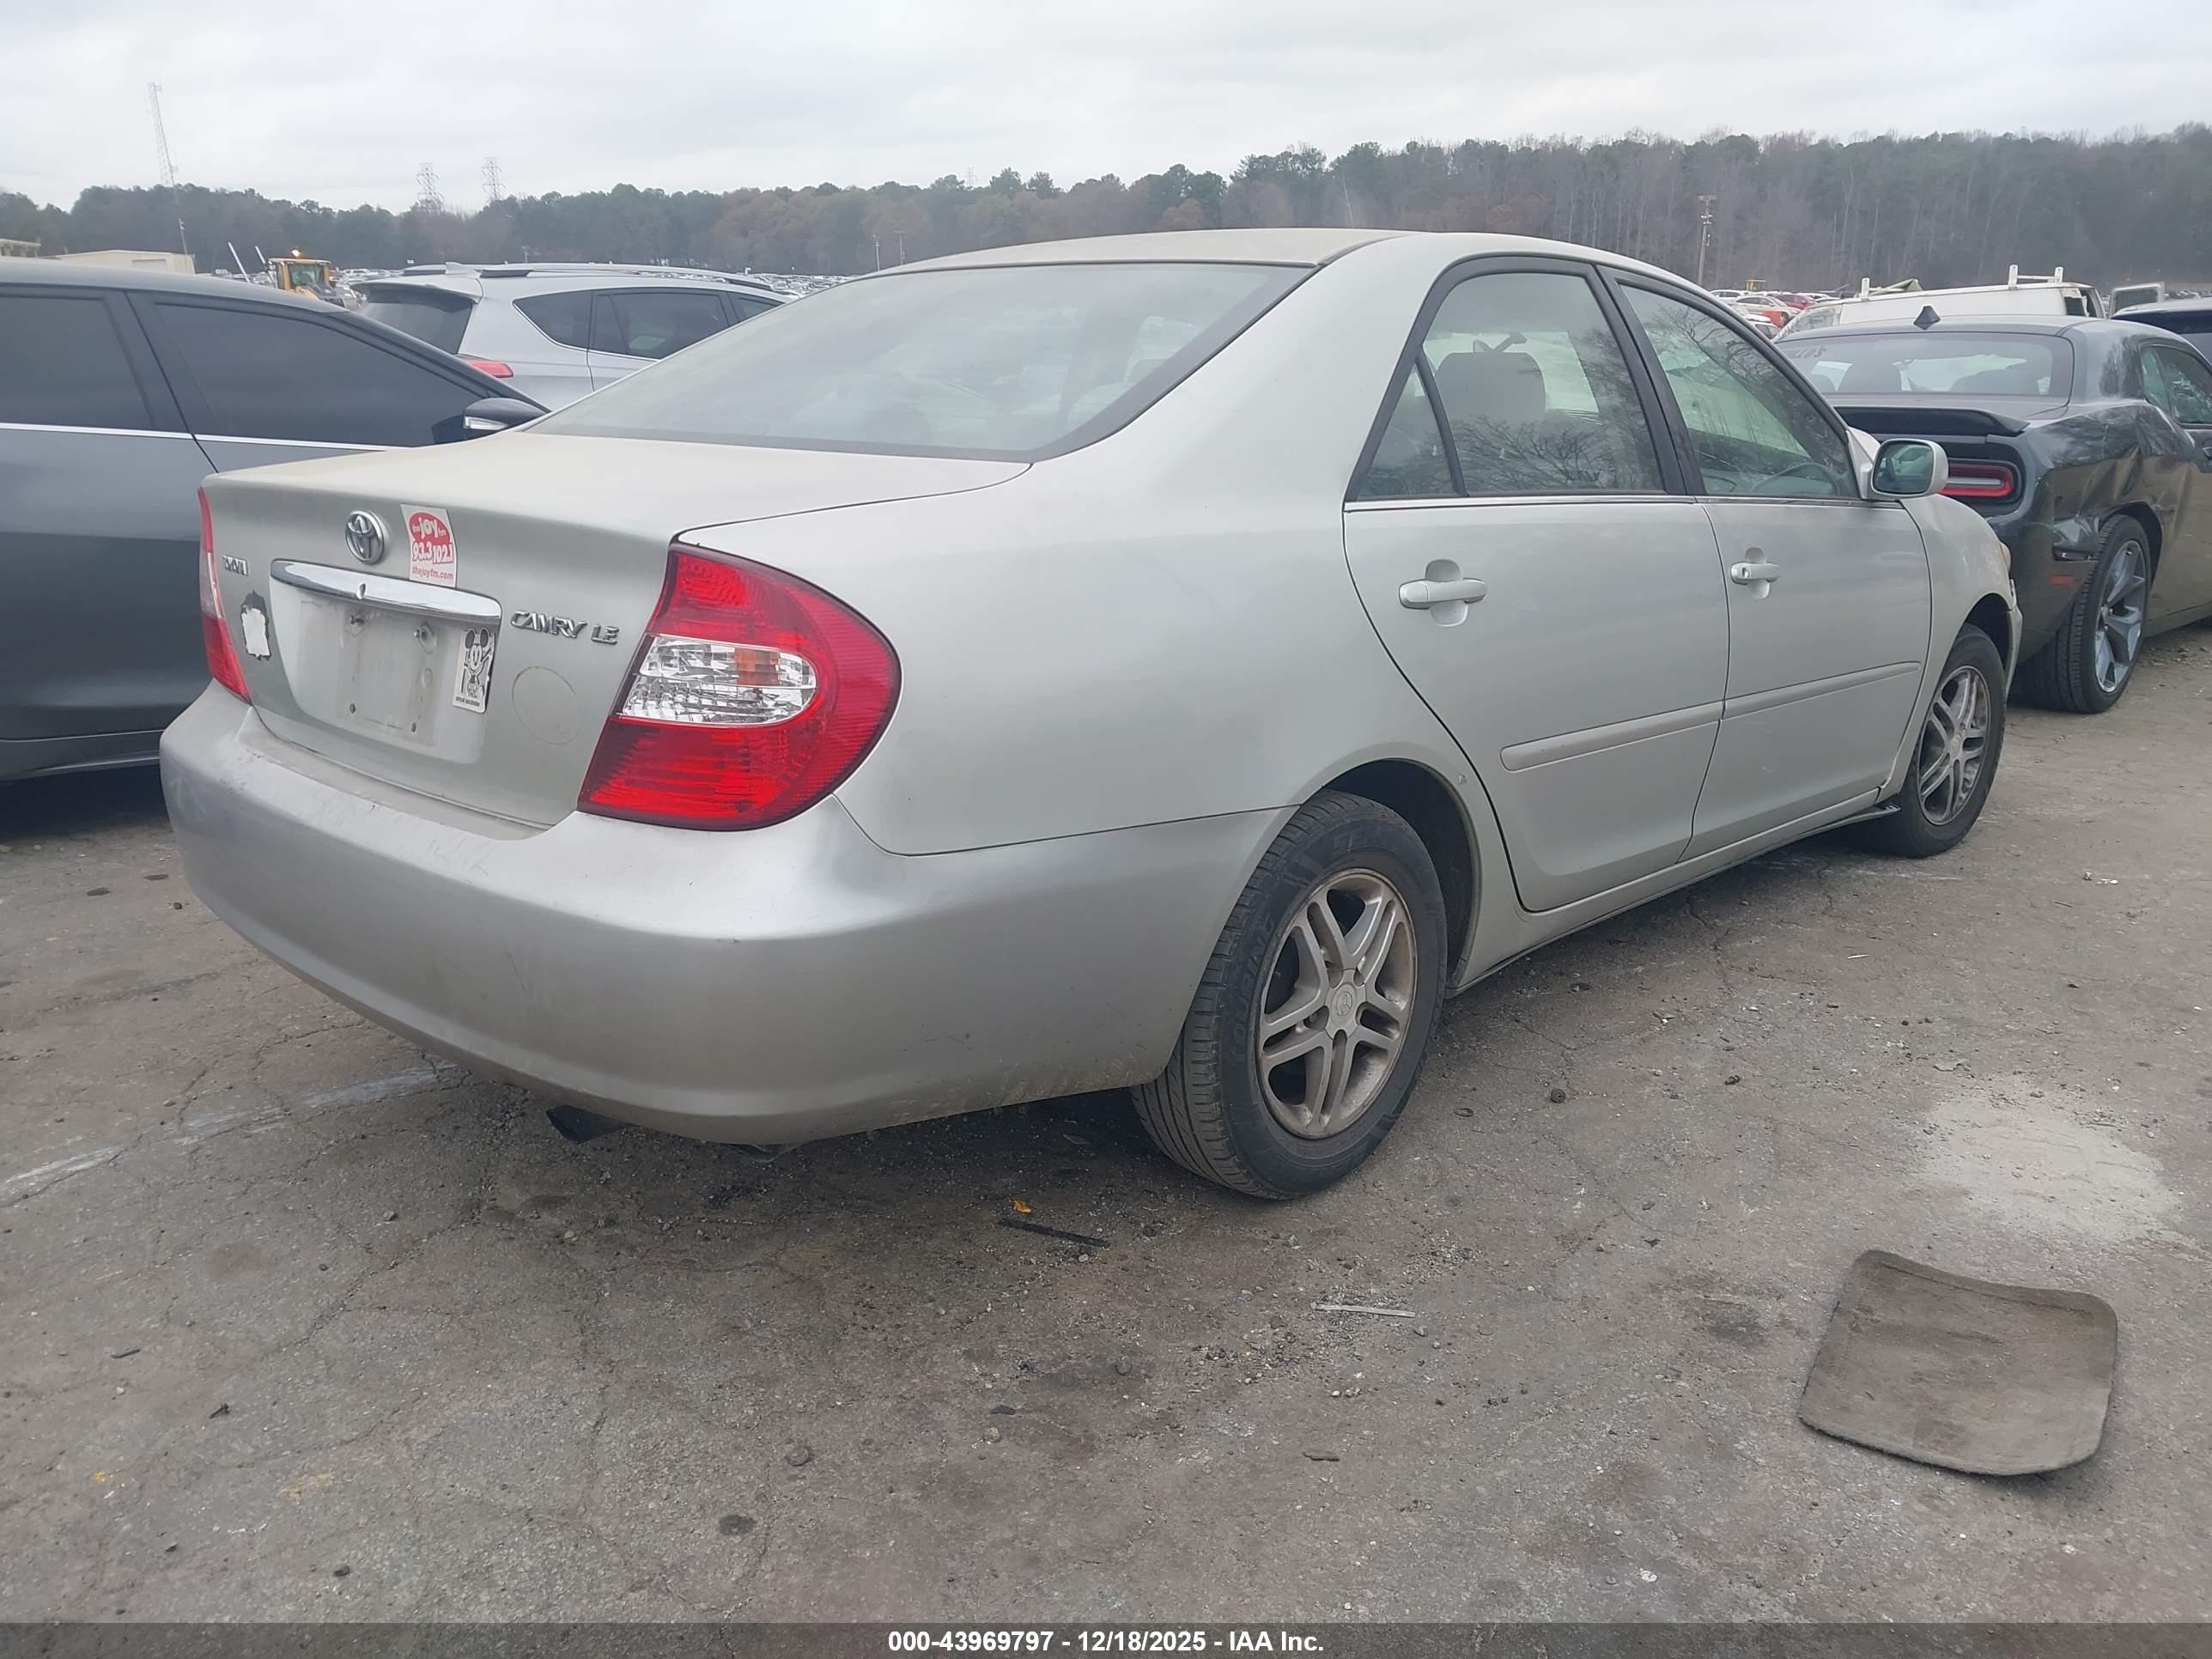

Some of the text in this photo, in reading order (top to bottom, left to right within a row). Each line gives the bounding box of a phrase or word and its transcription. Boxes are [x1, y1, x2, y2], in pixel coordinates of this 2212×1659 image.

[418, 517, 439, 539] joy
[412, 541, 453, 564] 93.3 102.1
[412, 565, 453, 580] thejoyfm.com
[510, 609, 619, 645] CAMRY LE
